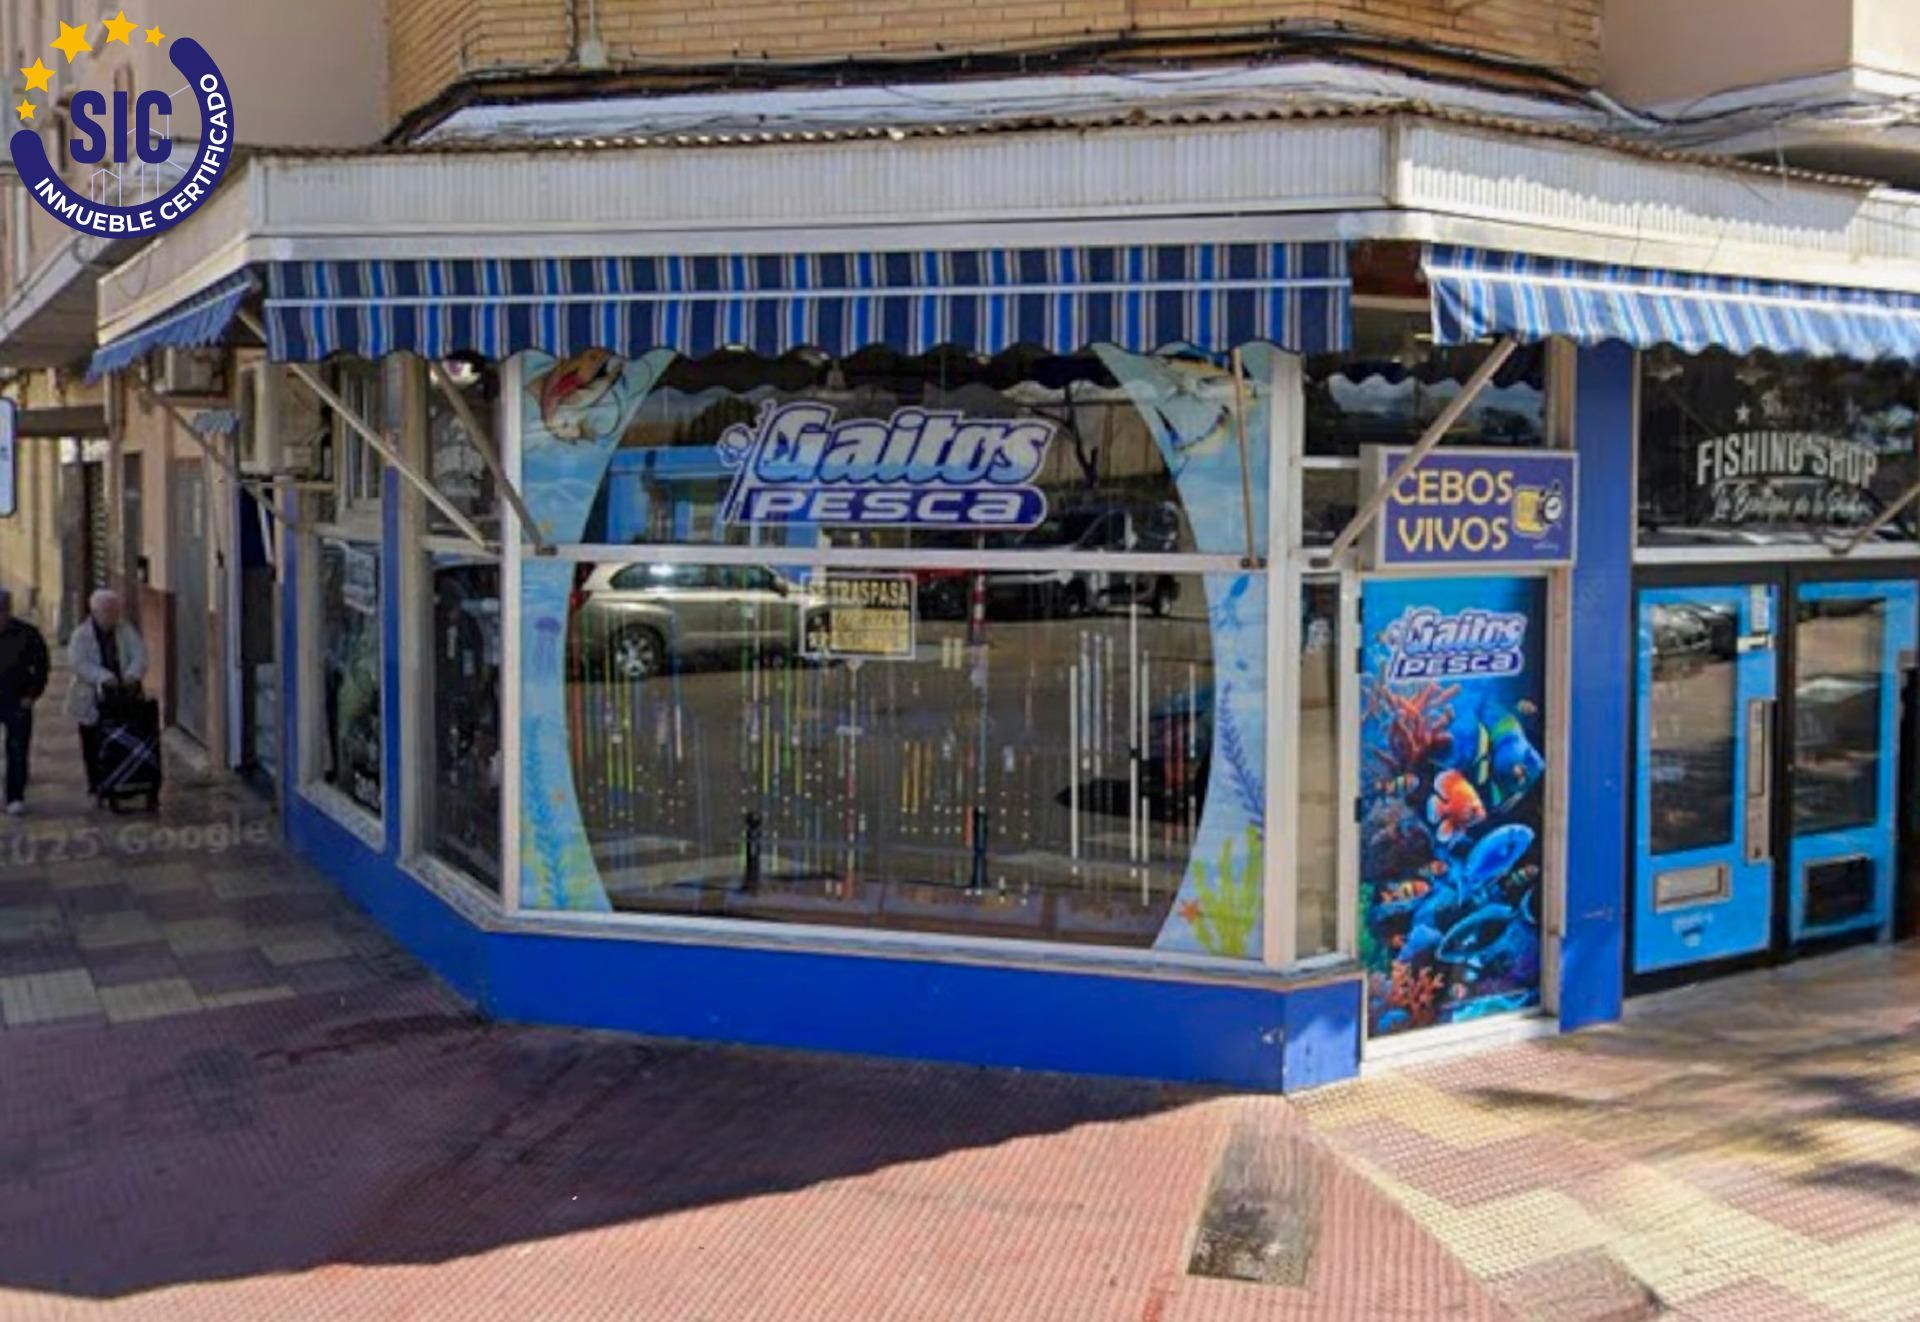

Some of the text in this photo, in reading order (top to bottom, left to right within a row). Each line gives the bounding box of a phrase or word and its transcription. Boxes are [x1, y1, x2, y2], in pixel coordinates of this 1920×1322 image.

[754, 403, 1052, 486] Gaitos
[1697, 431, 1878, 489] FISHING SHOP
[1393, 468, 1514, 505] CEBOS
[1397, 516, 1509, 552] VIVOS
